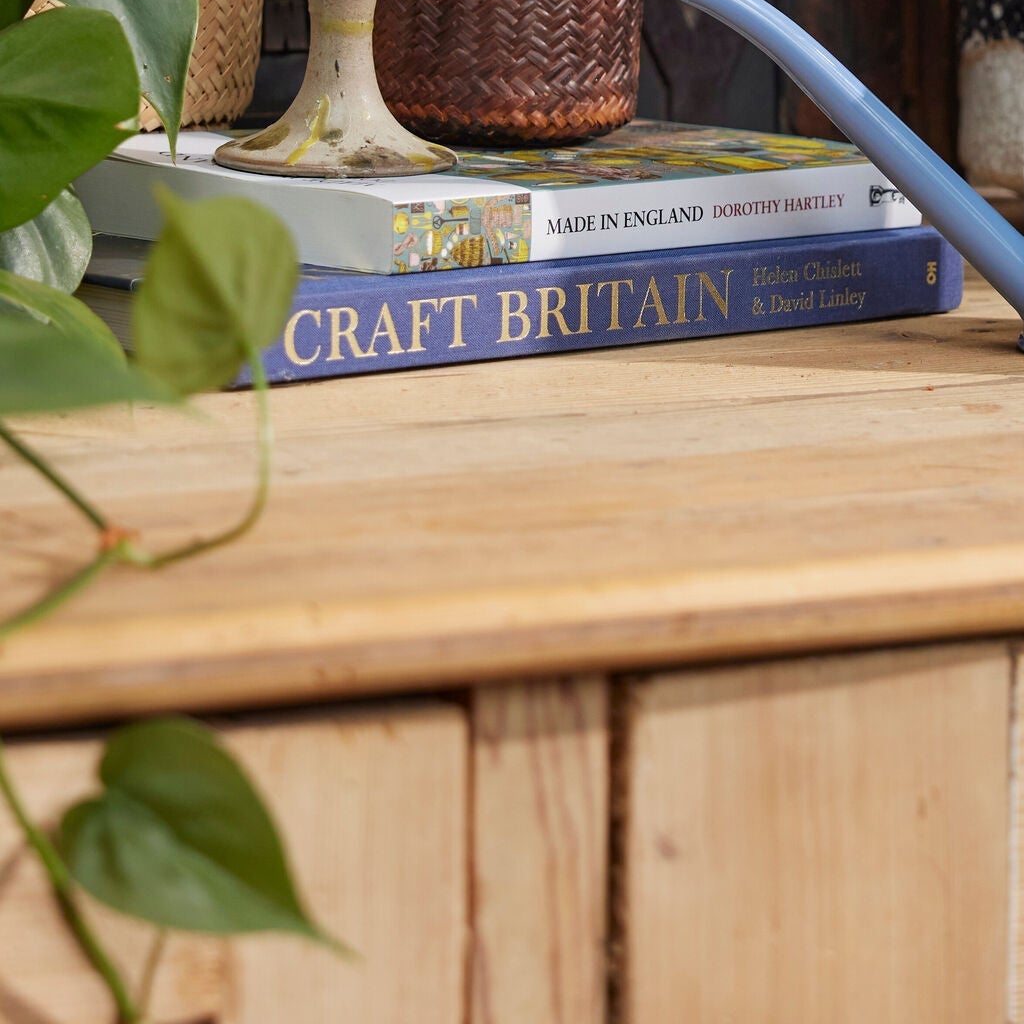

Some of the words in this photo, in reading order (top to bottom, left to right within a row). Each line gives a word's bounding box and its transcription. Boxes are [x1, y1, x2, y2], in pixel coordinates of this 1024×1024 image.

[547, 215, 596, 235] MADE
[600, 213, 618, 230] IN
[623, 205, 704, 228] ENGLAND
[712, 199, 781, 218] DOROTHY
[784, 193, 846, 212] HARTLEY
[752, 265, 799, 287] Helen
[803, 259, 862, 281] Chislett
[751, 296, 766, 316] &
[769, 290, 815, 314] David
[818, 286, 867, 312] Linley
[283, 294, 478, 366] CRAFT
[496, 269, 734, 343] BRITAIN
